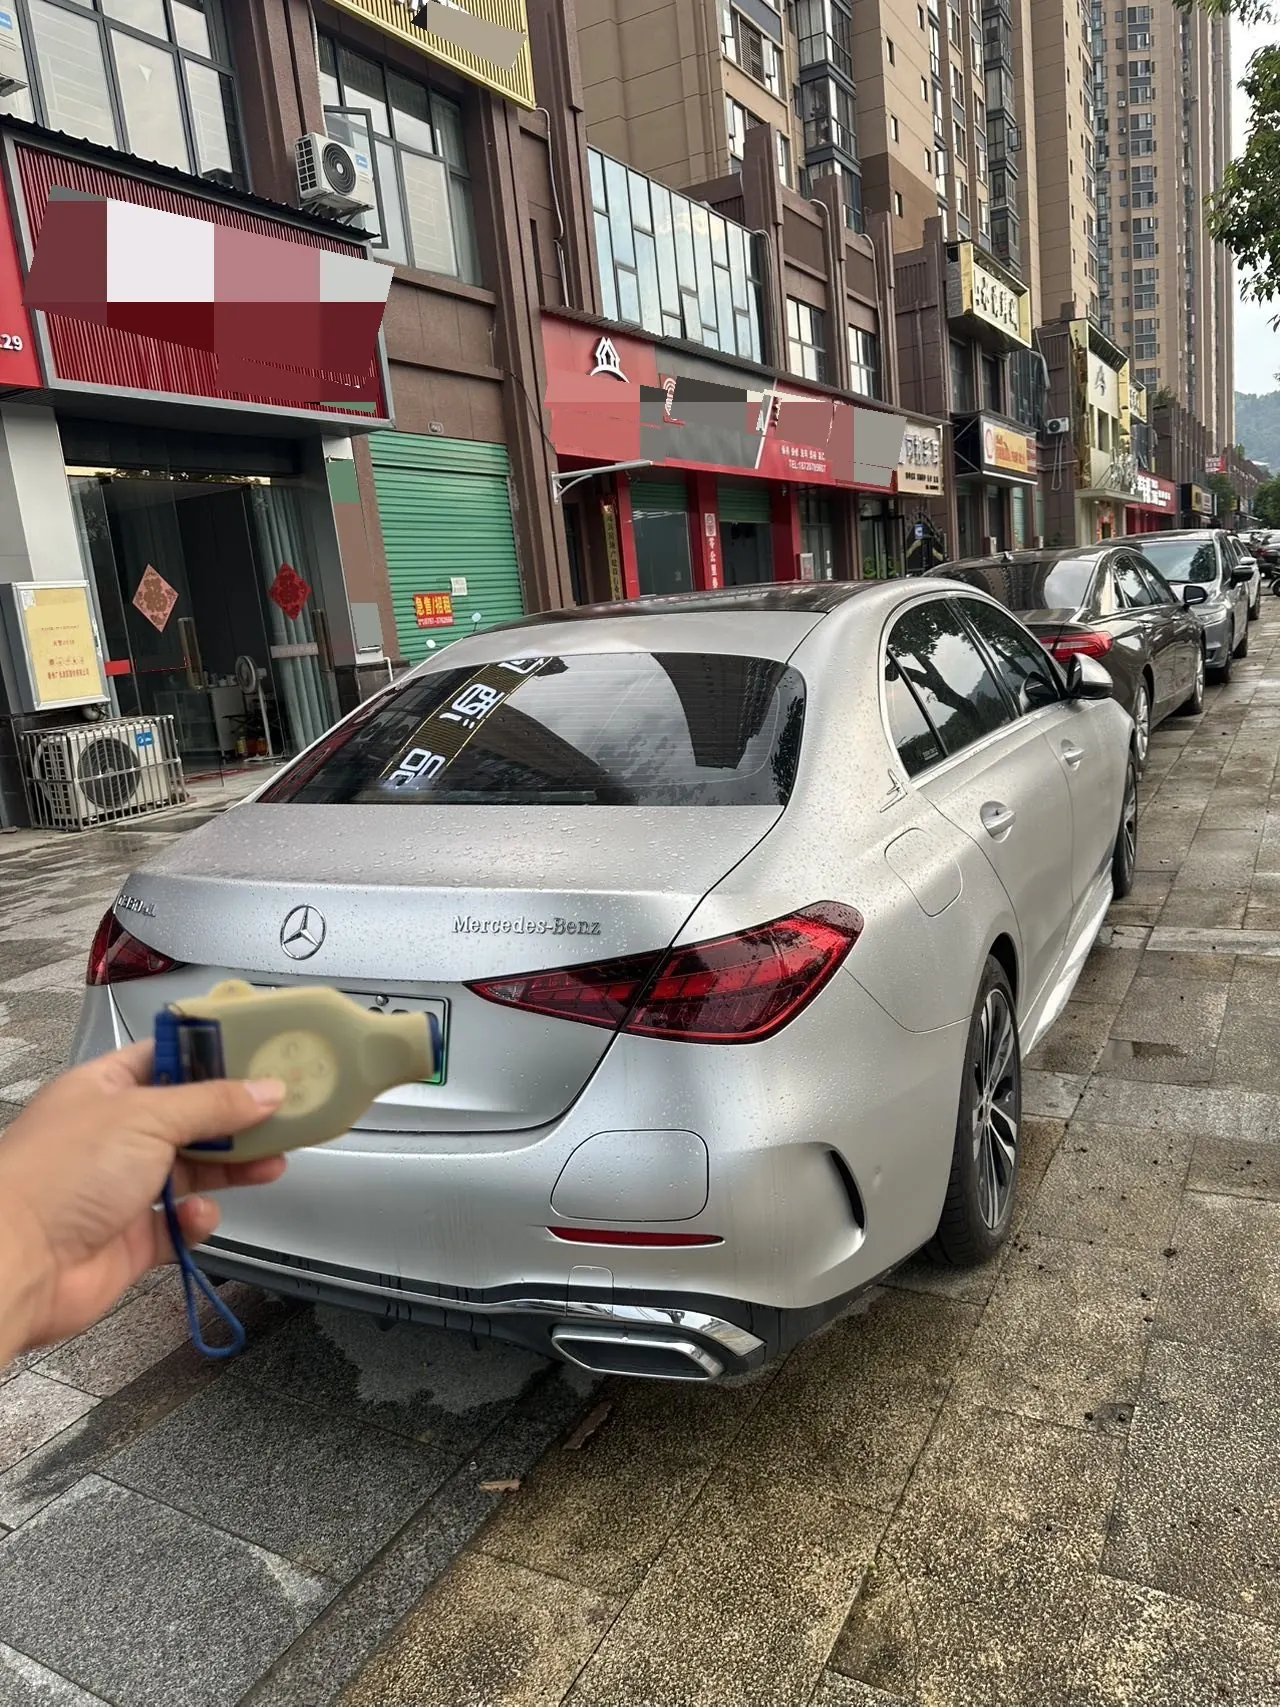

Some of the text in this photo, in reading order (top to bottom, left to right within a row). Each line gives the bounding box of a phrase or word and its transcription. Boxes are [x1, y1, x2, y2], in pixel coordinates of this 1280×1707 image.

[415, 595, 452, 616] 急售/招租
[451, 915, 601, 936] Mercedes-Benz
